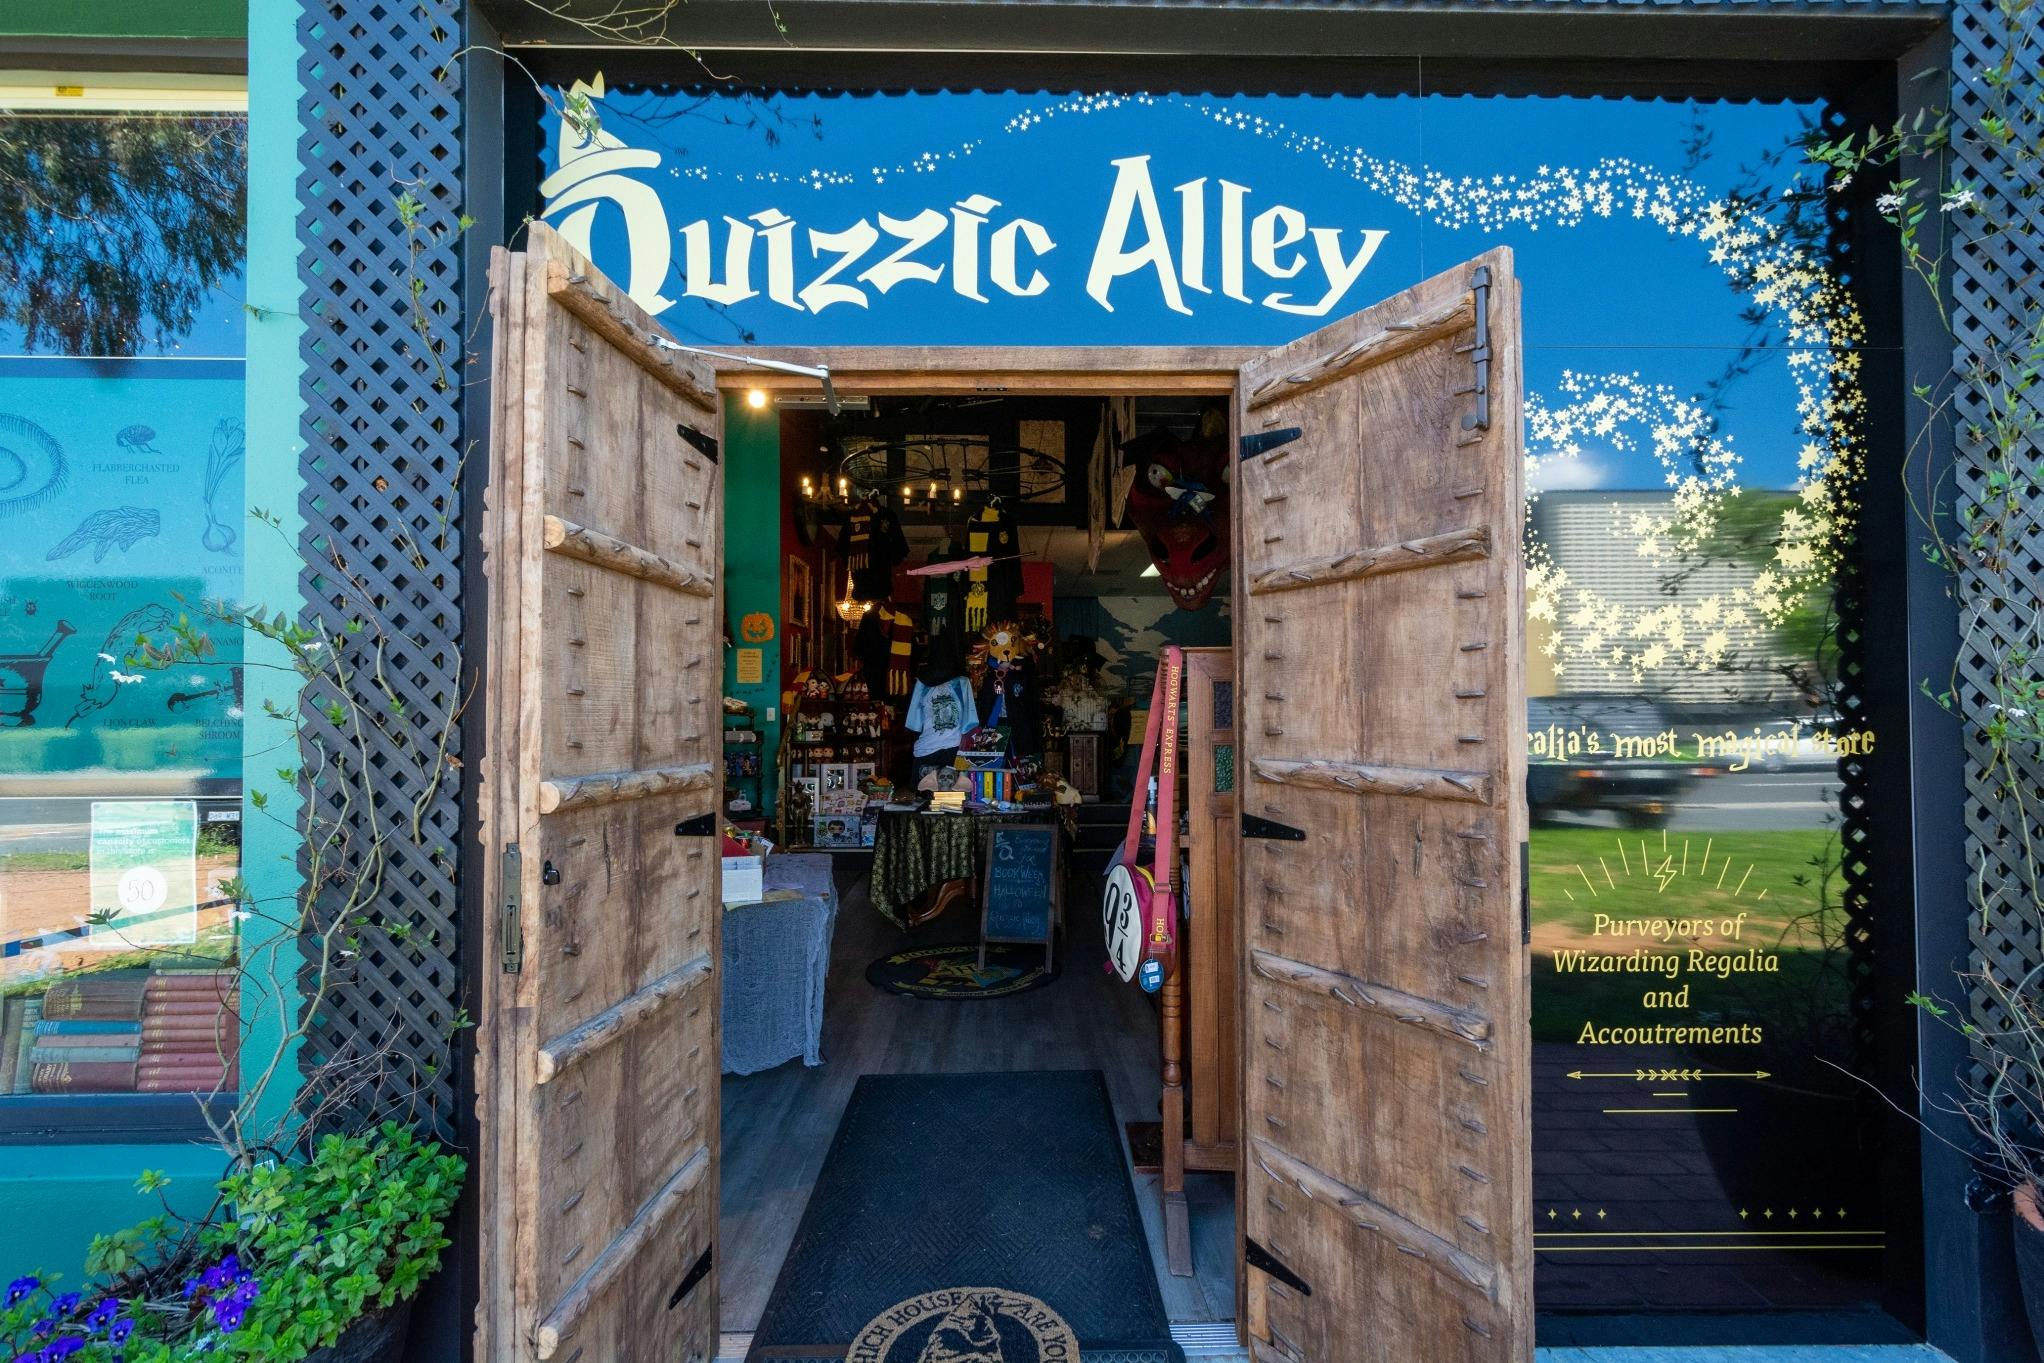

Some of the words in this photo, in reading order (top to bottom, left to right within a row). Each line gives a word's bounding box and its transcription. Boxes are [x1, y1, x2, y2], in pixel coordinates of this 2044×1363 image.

[540, 172, 1056, 314] Quizzic
[1086, 154, 1390, 317] Alley
[124, 475, 150, 485] FLEA
[89, 592, 118, 601] ROOT
[1166, 666, 1179, 721] HOGWARTS
[199, 730, 240, 740] SHROOM
[1610, 727, 1682, 758] most
[1692, 722, 1800, 772] magical
[1812, 726, 1875, 758] store
[1163, 729, 1173, 774] EXPRESS
[127, 879, 155, 903] 50
[1156, 918, 1165, 937] HO
[1593, 913, 1714, 942] Purveyors
[1719, 912, 1746, 941] of
[1553, 949, 1680, 977] Wizarding
[1687, 949, 1779, 977] Regalia
[1643, 985, 1690, 1008] and
[1577, 1021, 1763, 1044] Accoutrements
[886, 1291, 963, 1327] HOUSE
[1014, 1303, 1059, 1333] ARE
